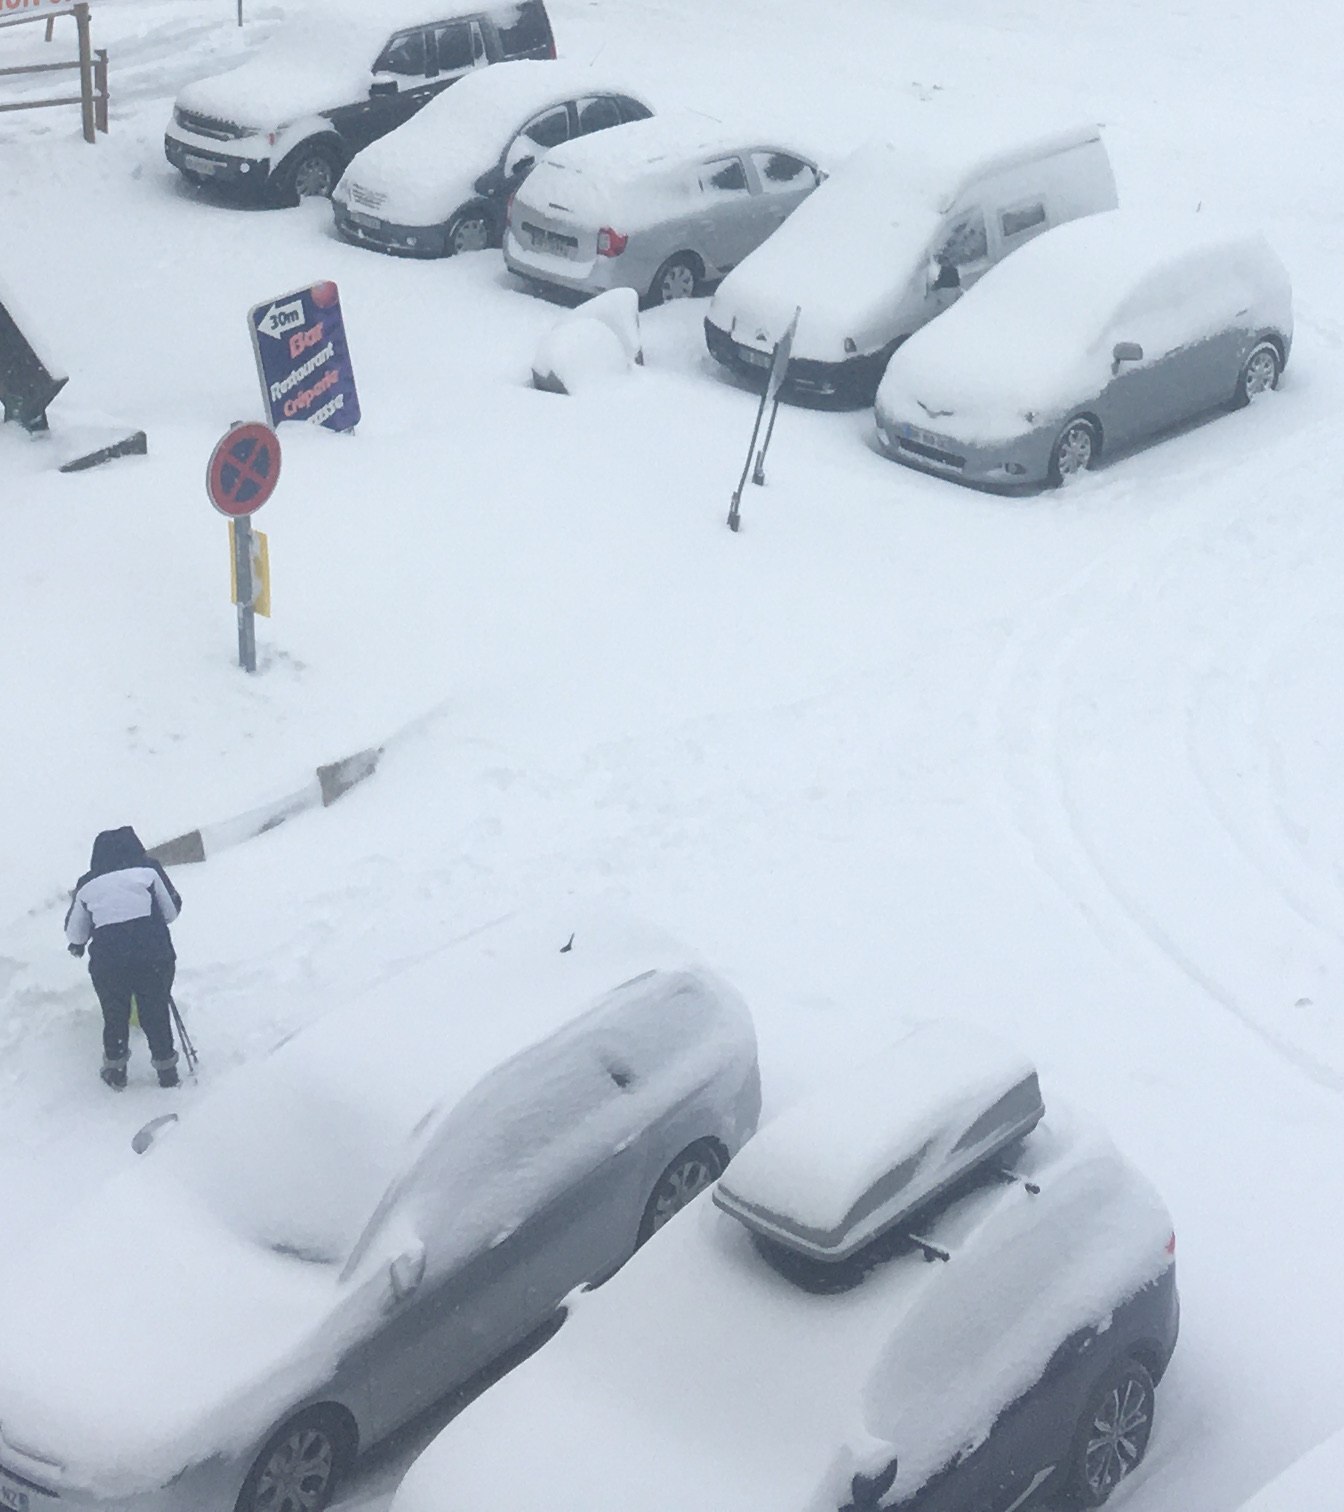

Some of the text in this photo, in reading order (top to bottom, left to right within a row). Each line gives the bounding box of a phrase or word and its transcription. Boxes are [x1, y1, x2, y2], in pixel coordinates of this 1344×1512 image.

[269, 309, 300, 331] 30m
[288, 321, 324, 359] Bar
[270, 342, 335, 402] Restaurant
